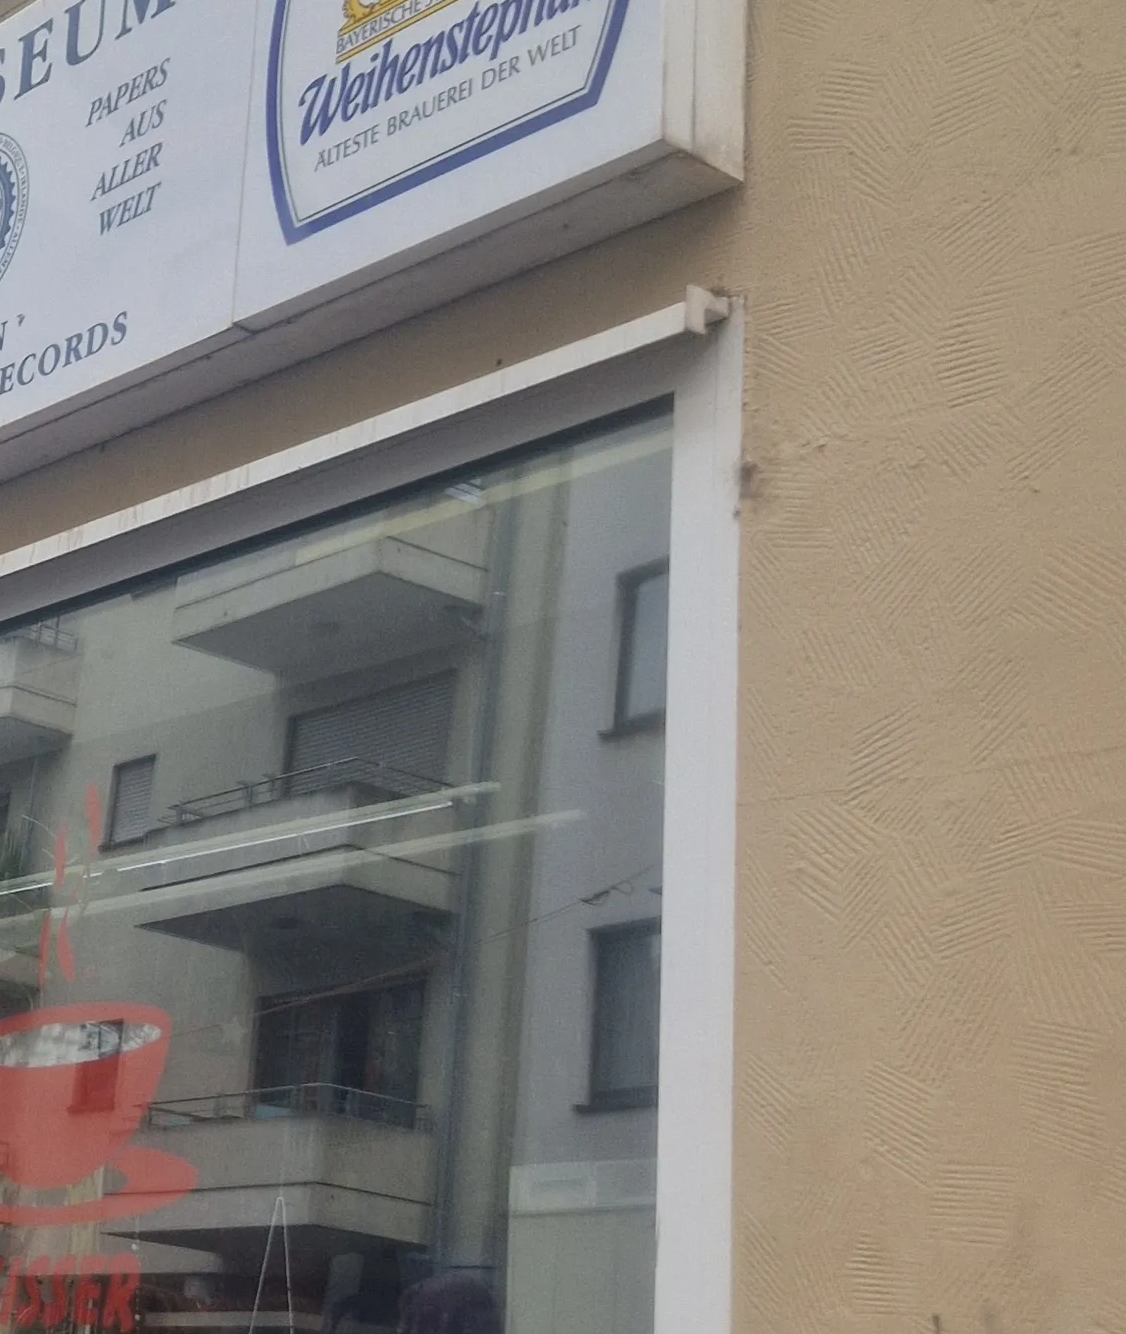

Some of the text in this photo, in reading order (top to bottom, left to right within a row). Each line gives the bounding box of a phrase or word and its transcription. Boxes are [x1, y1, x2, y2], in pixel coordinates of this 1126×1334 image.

[85, 57, 171, 128] PAPERS
[314, 23, 583, 174] ÄLTESTE BRAUEREI DER WELT
[118, 99, 168, 148] AUS
[90, 141, 164, 202] ALLER
[98, 180, 163, 236] WELT
